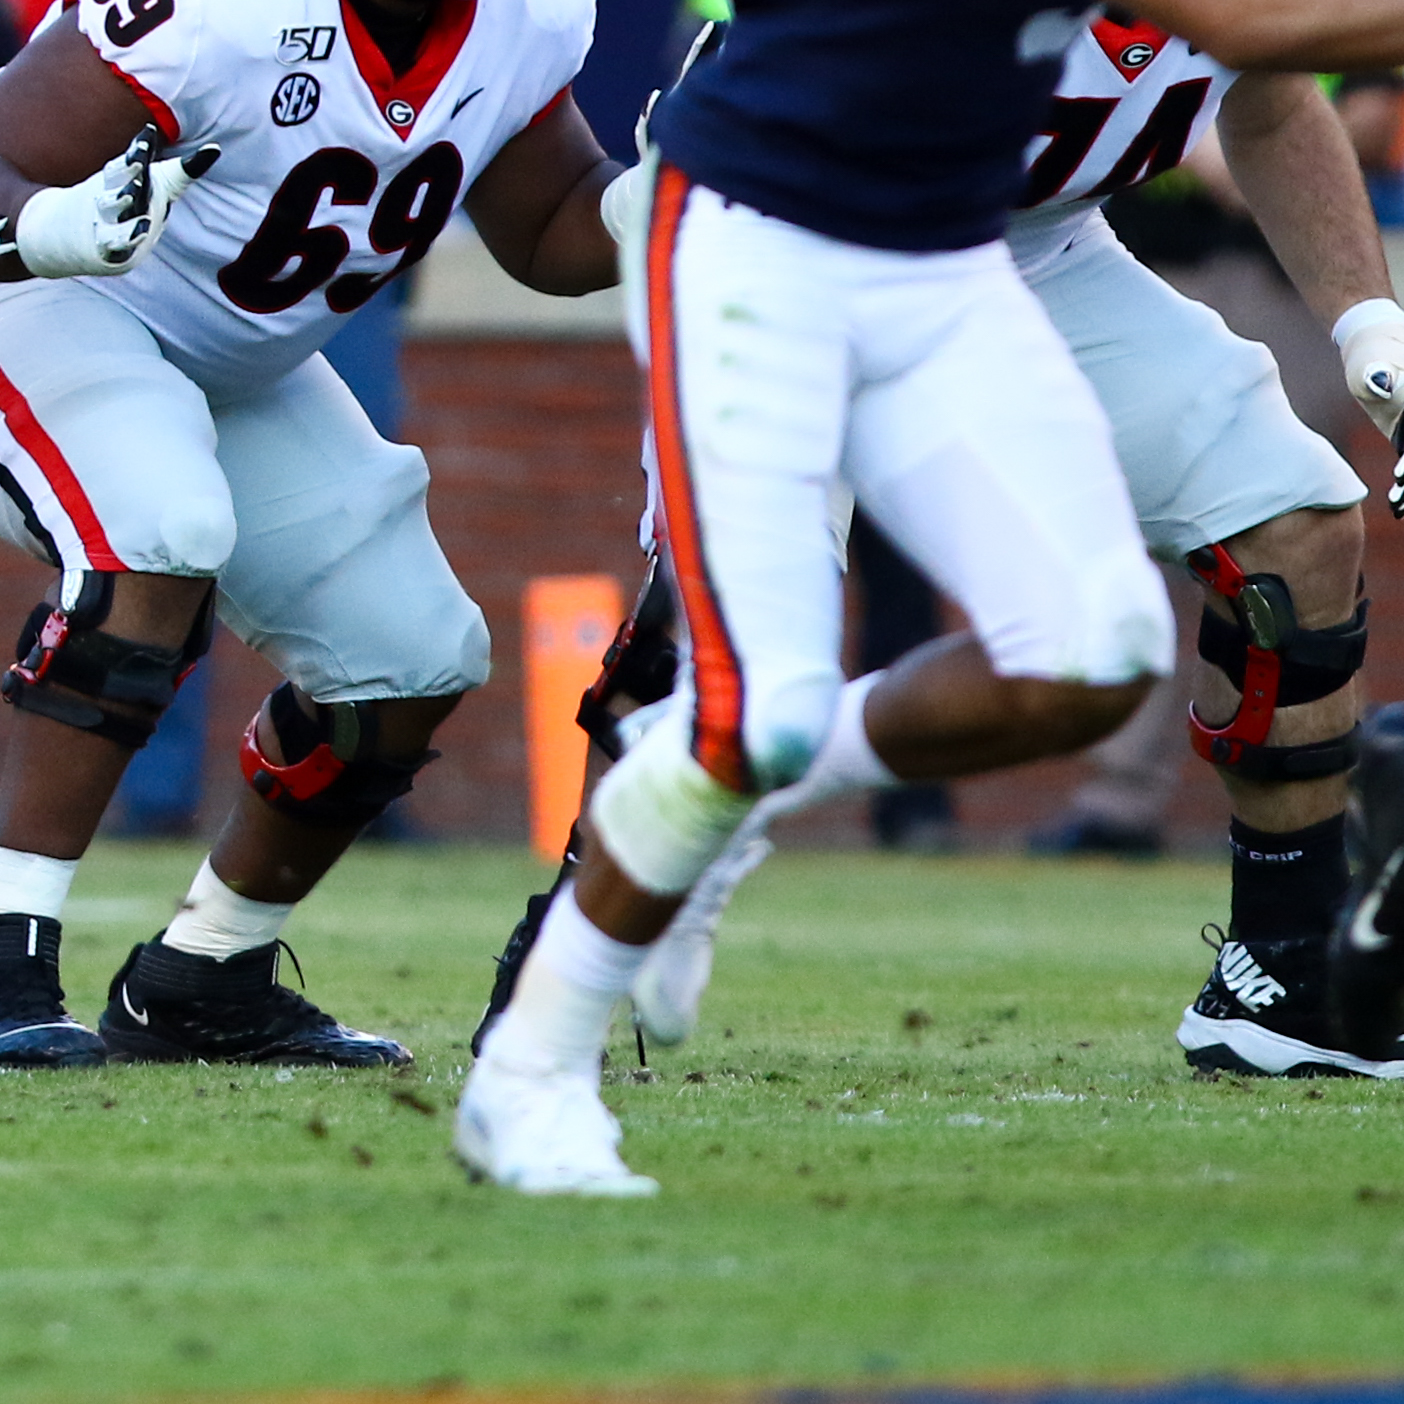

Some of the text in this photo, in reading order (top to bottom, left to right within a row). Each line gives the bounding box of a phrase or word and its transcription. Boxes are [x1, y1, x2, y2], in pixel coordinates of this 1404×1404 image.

[276, 26, 337, 64] 150
[1120, 43, 1154, 68] G
[273, 74, 319, 124] SEC
[385, 99, 415, 127] G
[218, 141, 464, 315] 69
[1218, 940, 1287, 1014] NIKE
